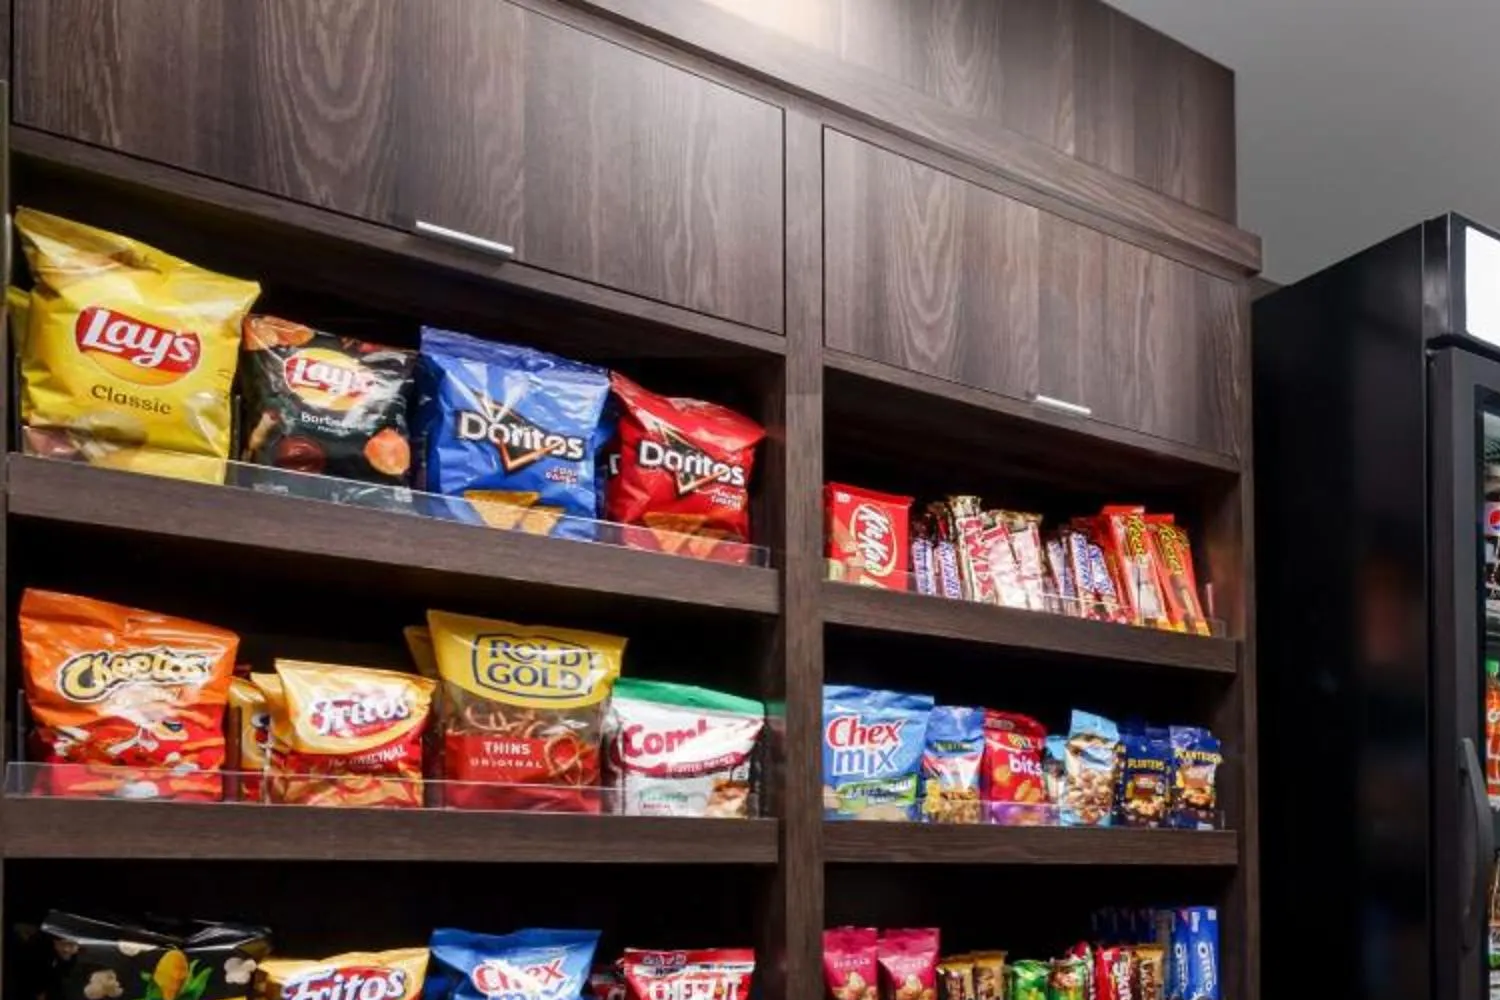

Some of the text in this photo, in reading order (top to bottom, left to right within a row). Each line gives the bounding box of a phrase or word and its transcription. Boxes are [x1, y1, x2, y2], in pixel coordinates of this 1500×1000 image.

[80, 308, 196, 369] Lay's
[91, 383, 172, 416] Classic
[459, 410, 584, 460] Doritos
[639, 439, 745, 486] Doritos
[490, 639, 583, 668] ROLD
[487, 663, 583, 691] GOLD
[483, 740, 532, 756] THINS
[827, 716, 904, 748] Chex
[834, 747, 897, 776] mix
